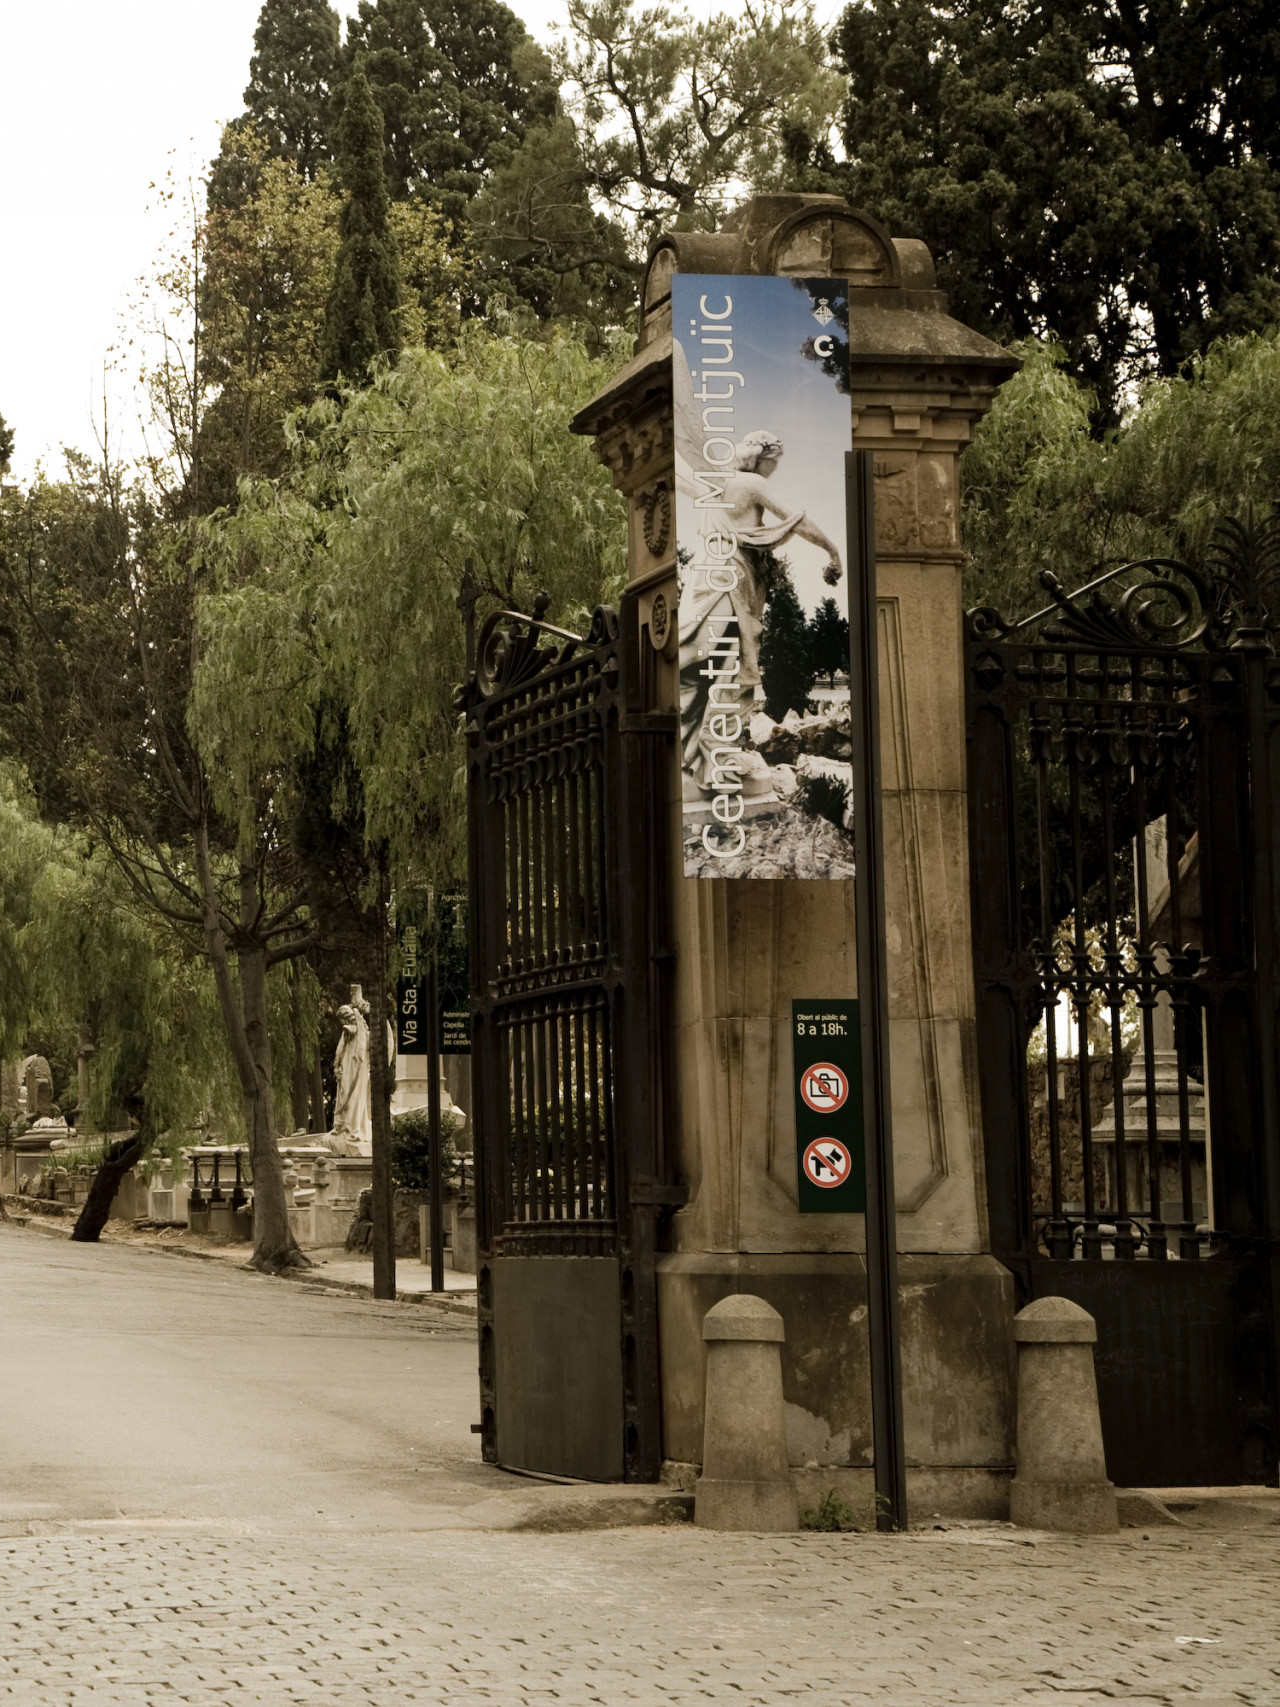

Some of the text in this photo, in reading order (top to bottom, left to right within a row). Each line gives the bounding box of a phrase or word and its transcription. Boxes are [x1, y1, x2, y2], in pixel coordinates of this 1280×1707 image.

[690, 294, 745, 858] Cementiri de Montjuïc
[402, 984, 418, 1015] Sta.
[402, 1020, 418, 1046] Via
[442, 1021, 465, 1029] Capella
[797, 1022, 848, 1036] 8 a 18h.
